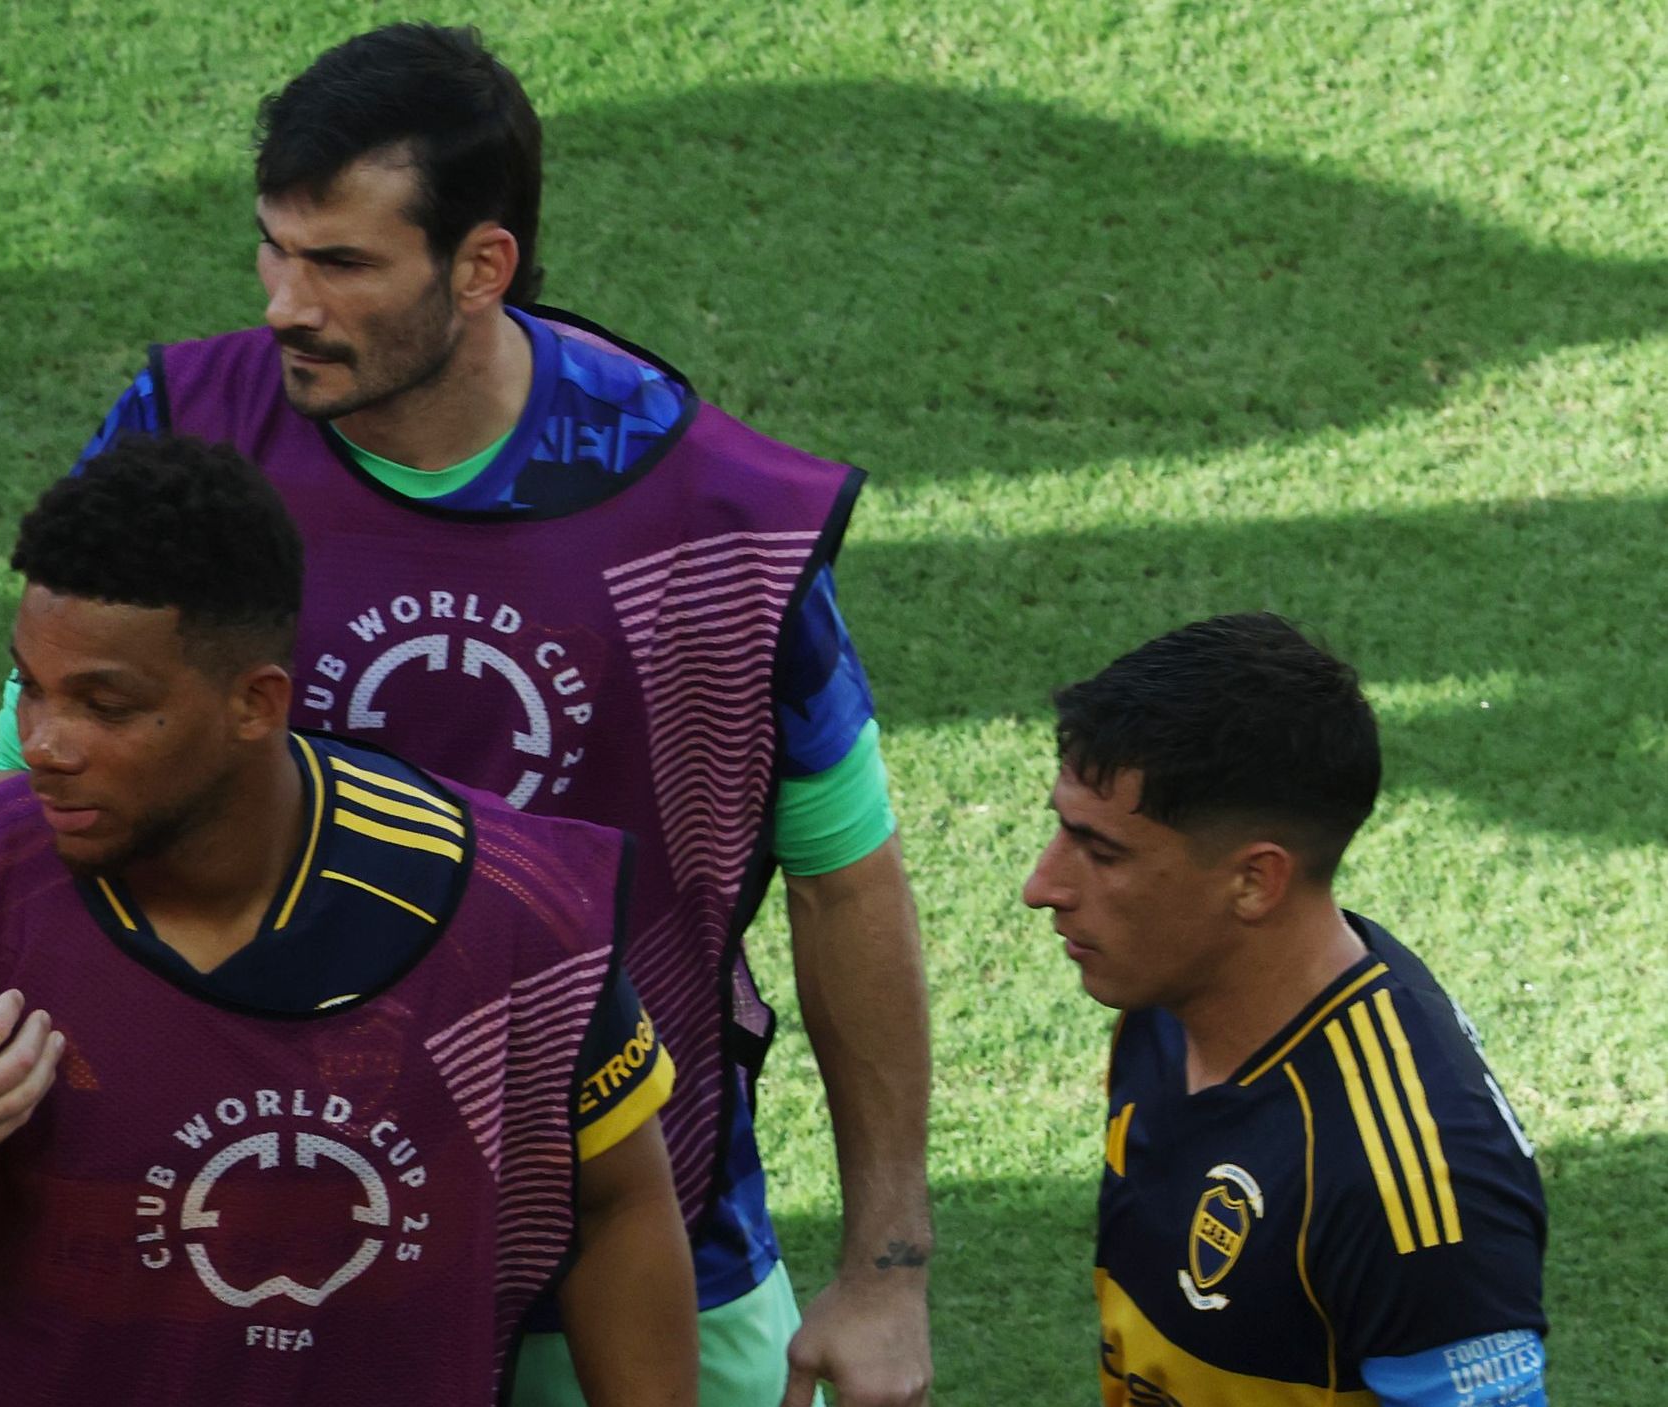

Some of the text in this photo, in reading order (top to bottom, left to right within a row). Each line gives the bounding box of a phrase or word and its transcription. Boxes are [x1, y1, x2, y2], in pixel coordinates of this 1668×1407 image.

[347, 591, 522, 642] WORLD
[535, 641, 593, 725] CUP
[136, 1089, 429, 1269] CLUB WORLD CUP 25
[246, 1325, 314, 1351] FIFA
[1450, 1342, 1542, 1393] UNITES
